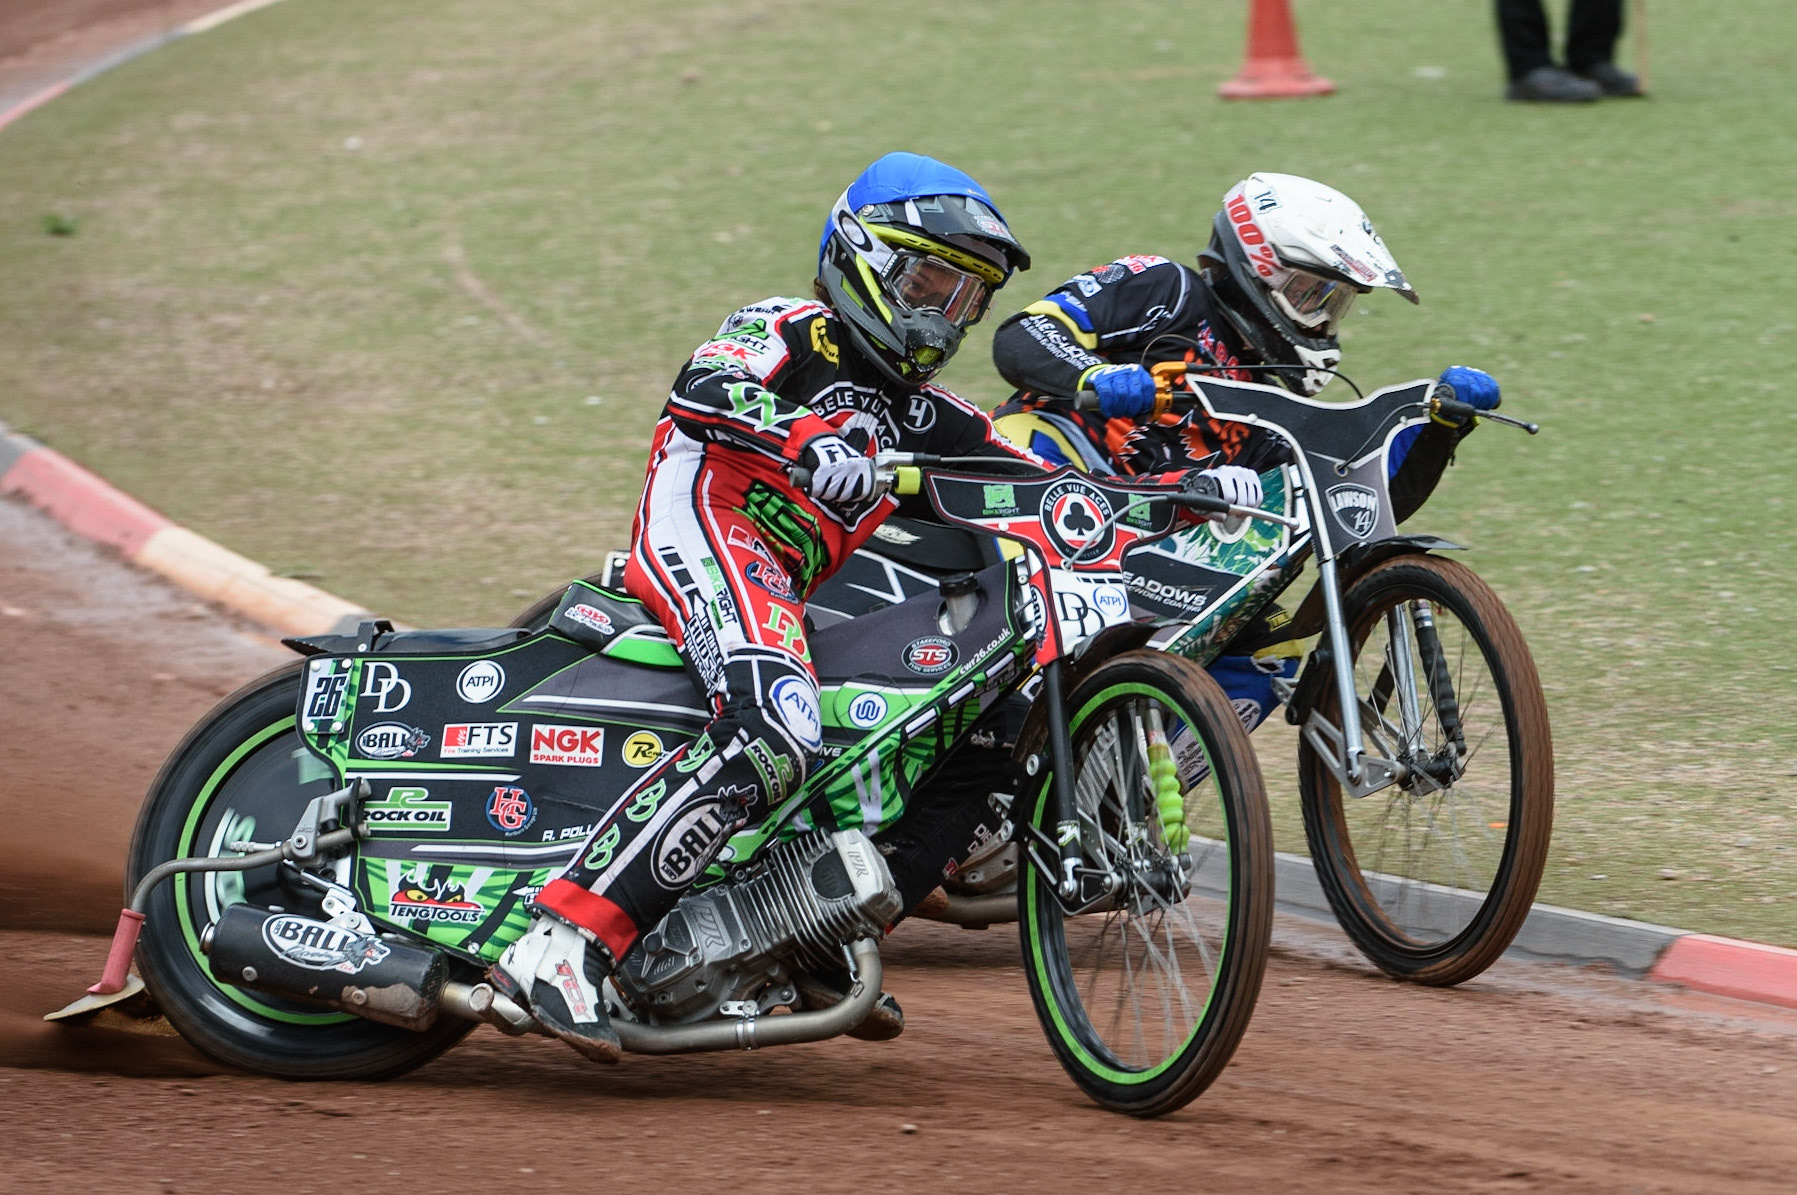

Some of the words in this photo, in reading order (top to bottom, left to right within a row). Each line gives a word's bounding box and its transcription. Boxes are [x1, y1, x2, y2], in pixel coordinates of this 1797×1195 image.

[1227, 194, 1283, 277] 100%
[819, 443, 860, 464] FL
[1044, 486, 1065, 512] BELLE
[1066, 484, 1087, 494] VUE
[1089, 492, 1110, 516] ACES
[1330, 491, 1377, 513] LAWSON
[1123, 571, 1207, 606] EADOWS
[911, 648, 948, 662] STS
[959, 627, 1011, 675] cwr26.co.uk
[466, 675, 494, 687] ATPI
[307, 674, 347, 718] 26
[467, 725, 513, 746] FTS
[533, 728, 601, 754] NGK
[533, 754, 565, 763] SPARK
[566, 756, 599, 764] PLUGS
[413, 810, 446, 822] OIL
